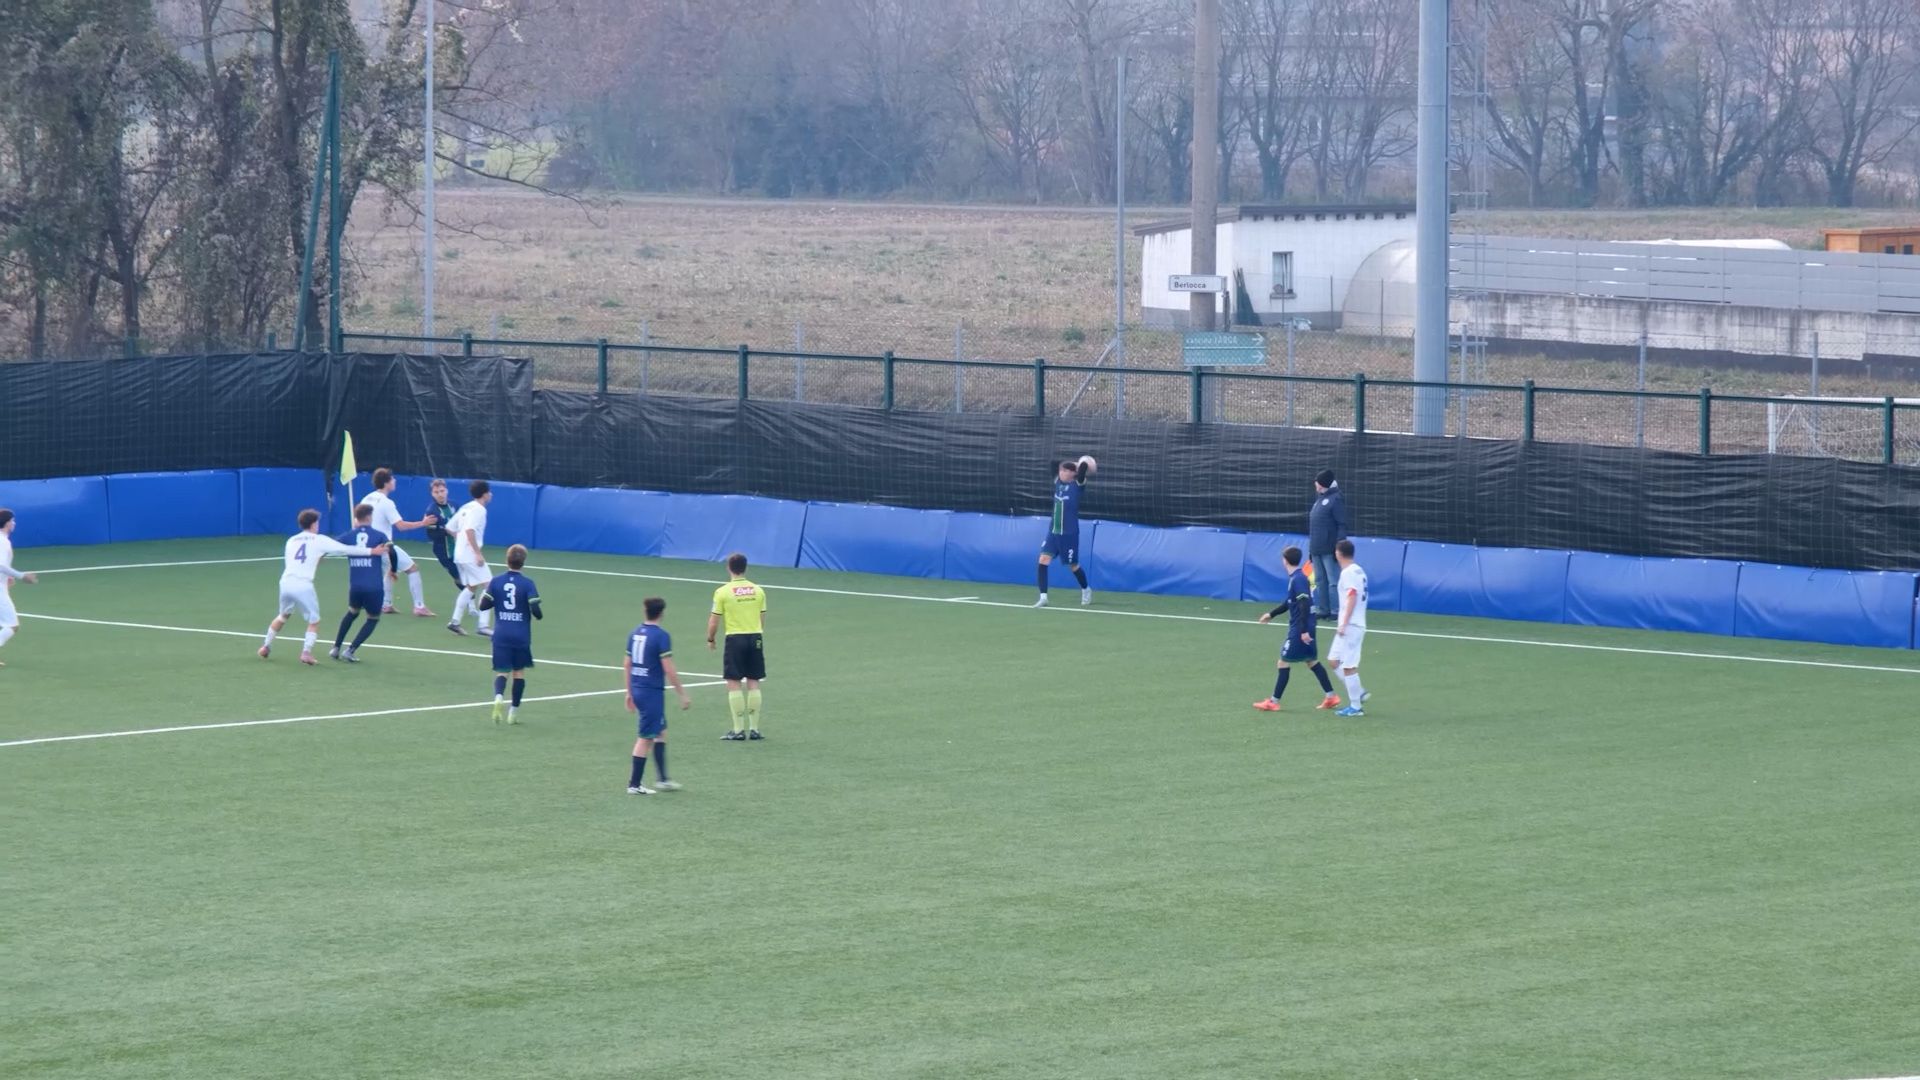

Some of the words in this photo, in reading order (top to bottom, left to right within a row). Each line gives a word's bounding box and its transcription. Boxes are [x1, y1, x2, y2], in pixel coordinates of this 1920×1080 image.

[1174, 281, 1206, 289] Berlocca
[294, 543, 307, 564] 4
[503, 582, 516, 610] 3
[631, 634, 648, 665] 11
